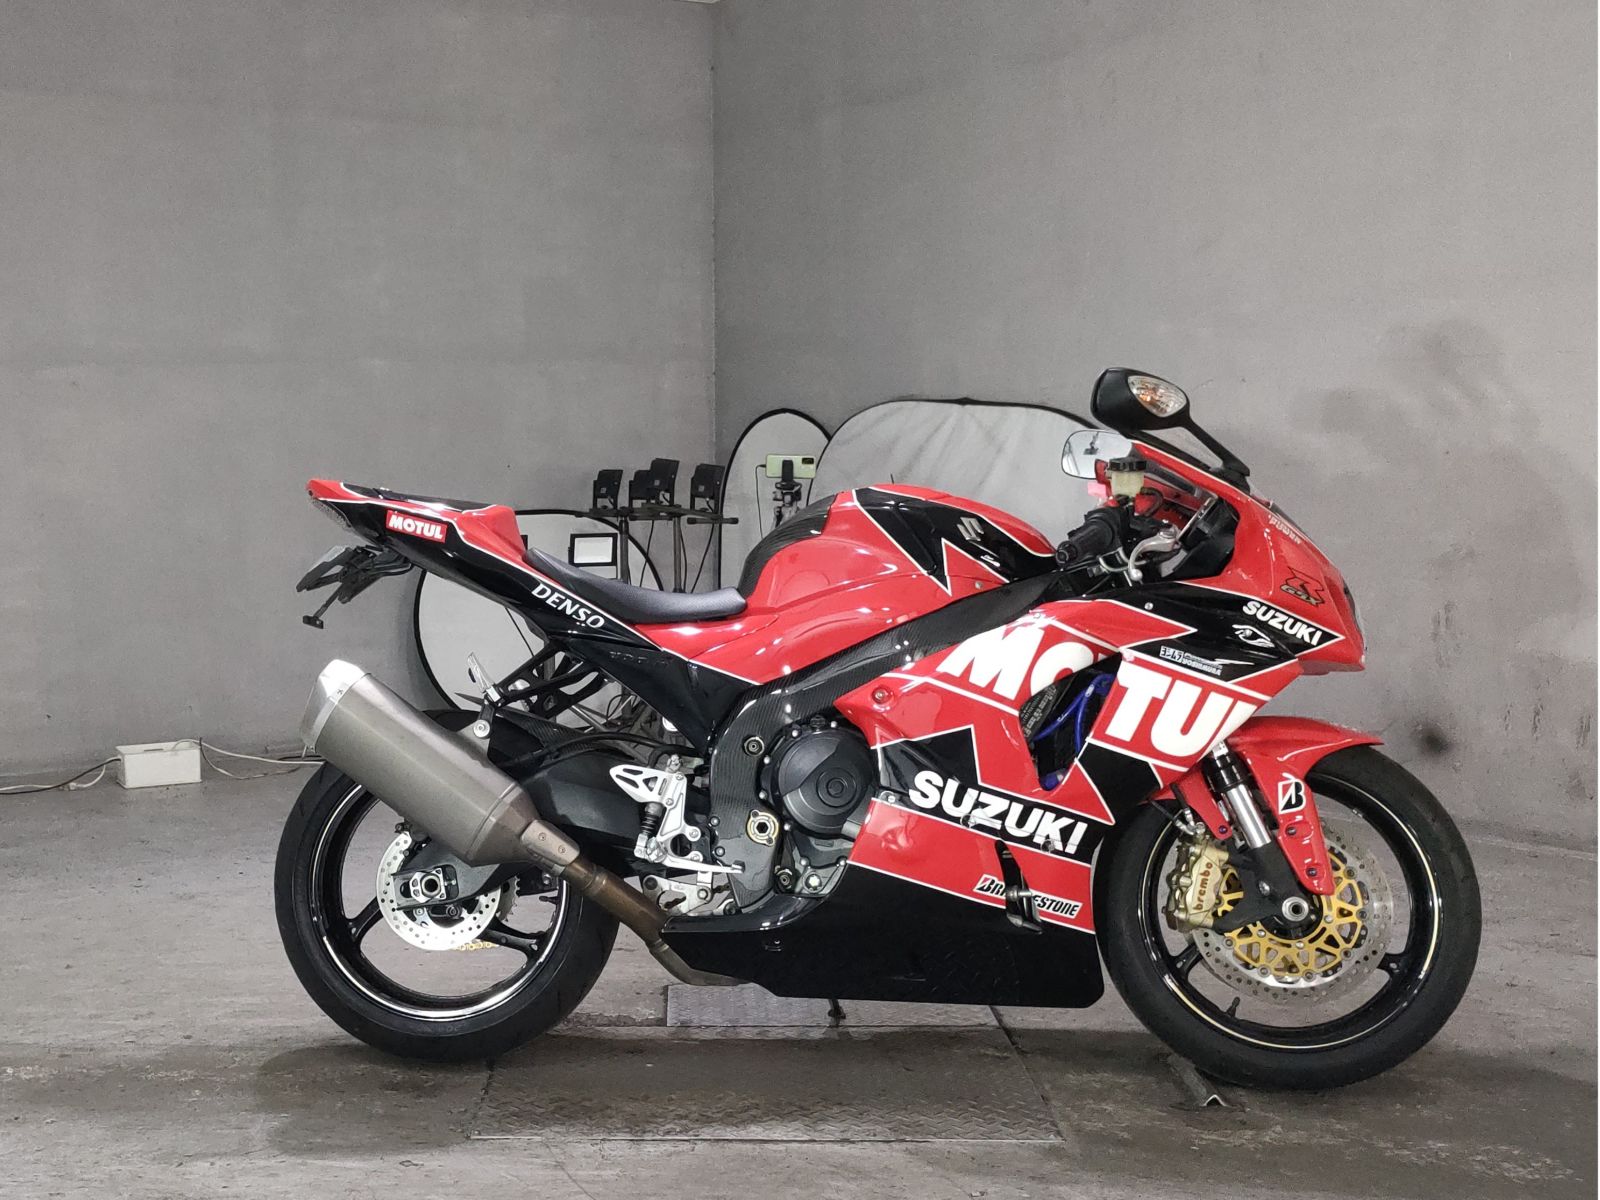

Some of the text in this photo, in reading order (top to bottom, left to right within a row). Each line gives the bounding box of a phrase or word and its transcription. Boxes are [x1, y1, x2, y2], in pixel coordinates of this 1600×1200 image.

[388, 514, 443, 540] MOTUL
[531, 582, 605, 630] DENSO
[1242, 600, 1322, 647] SUZUKI
[908, 770, 1088, 855] SUZUKI
[1193, 862, 1213, 911] brembo
